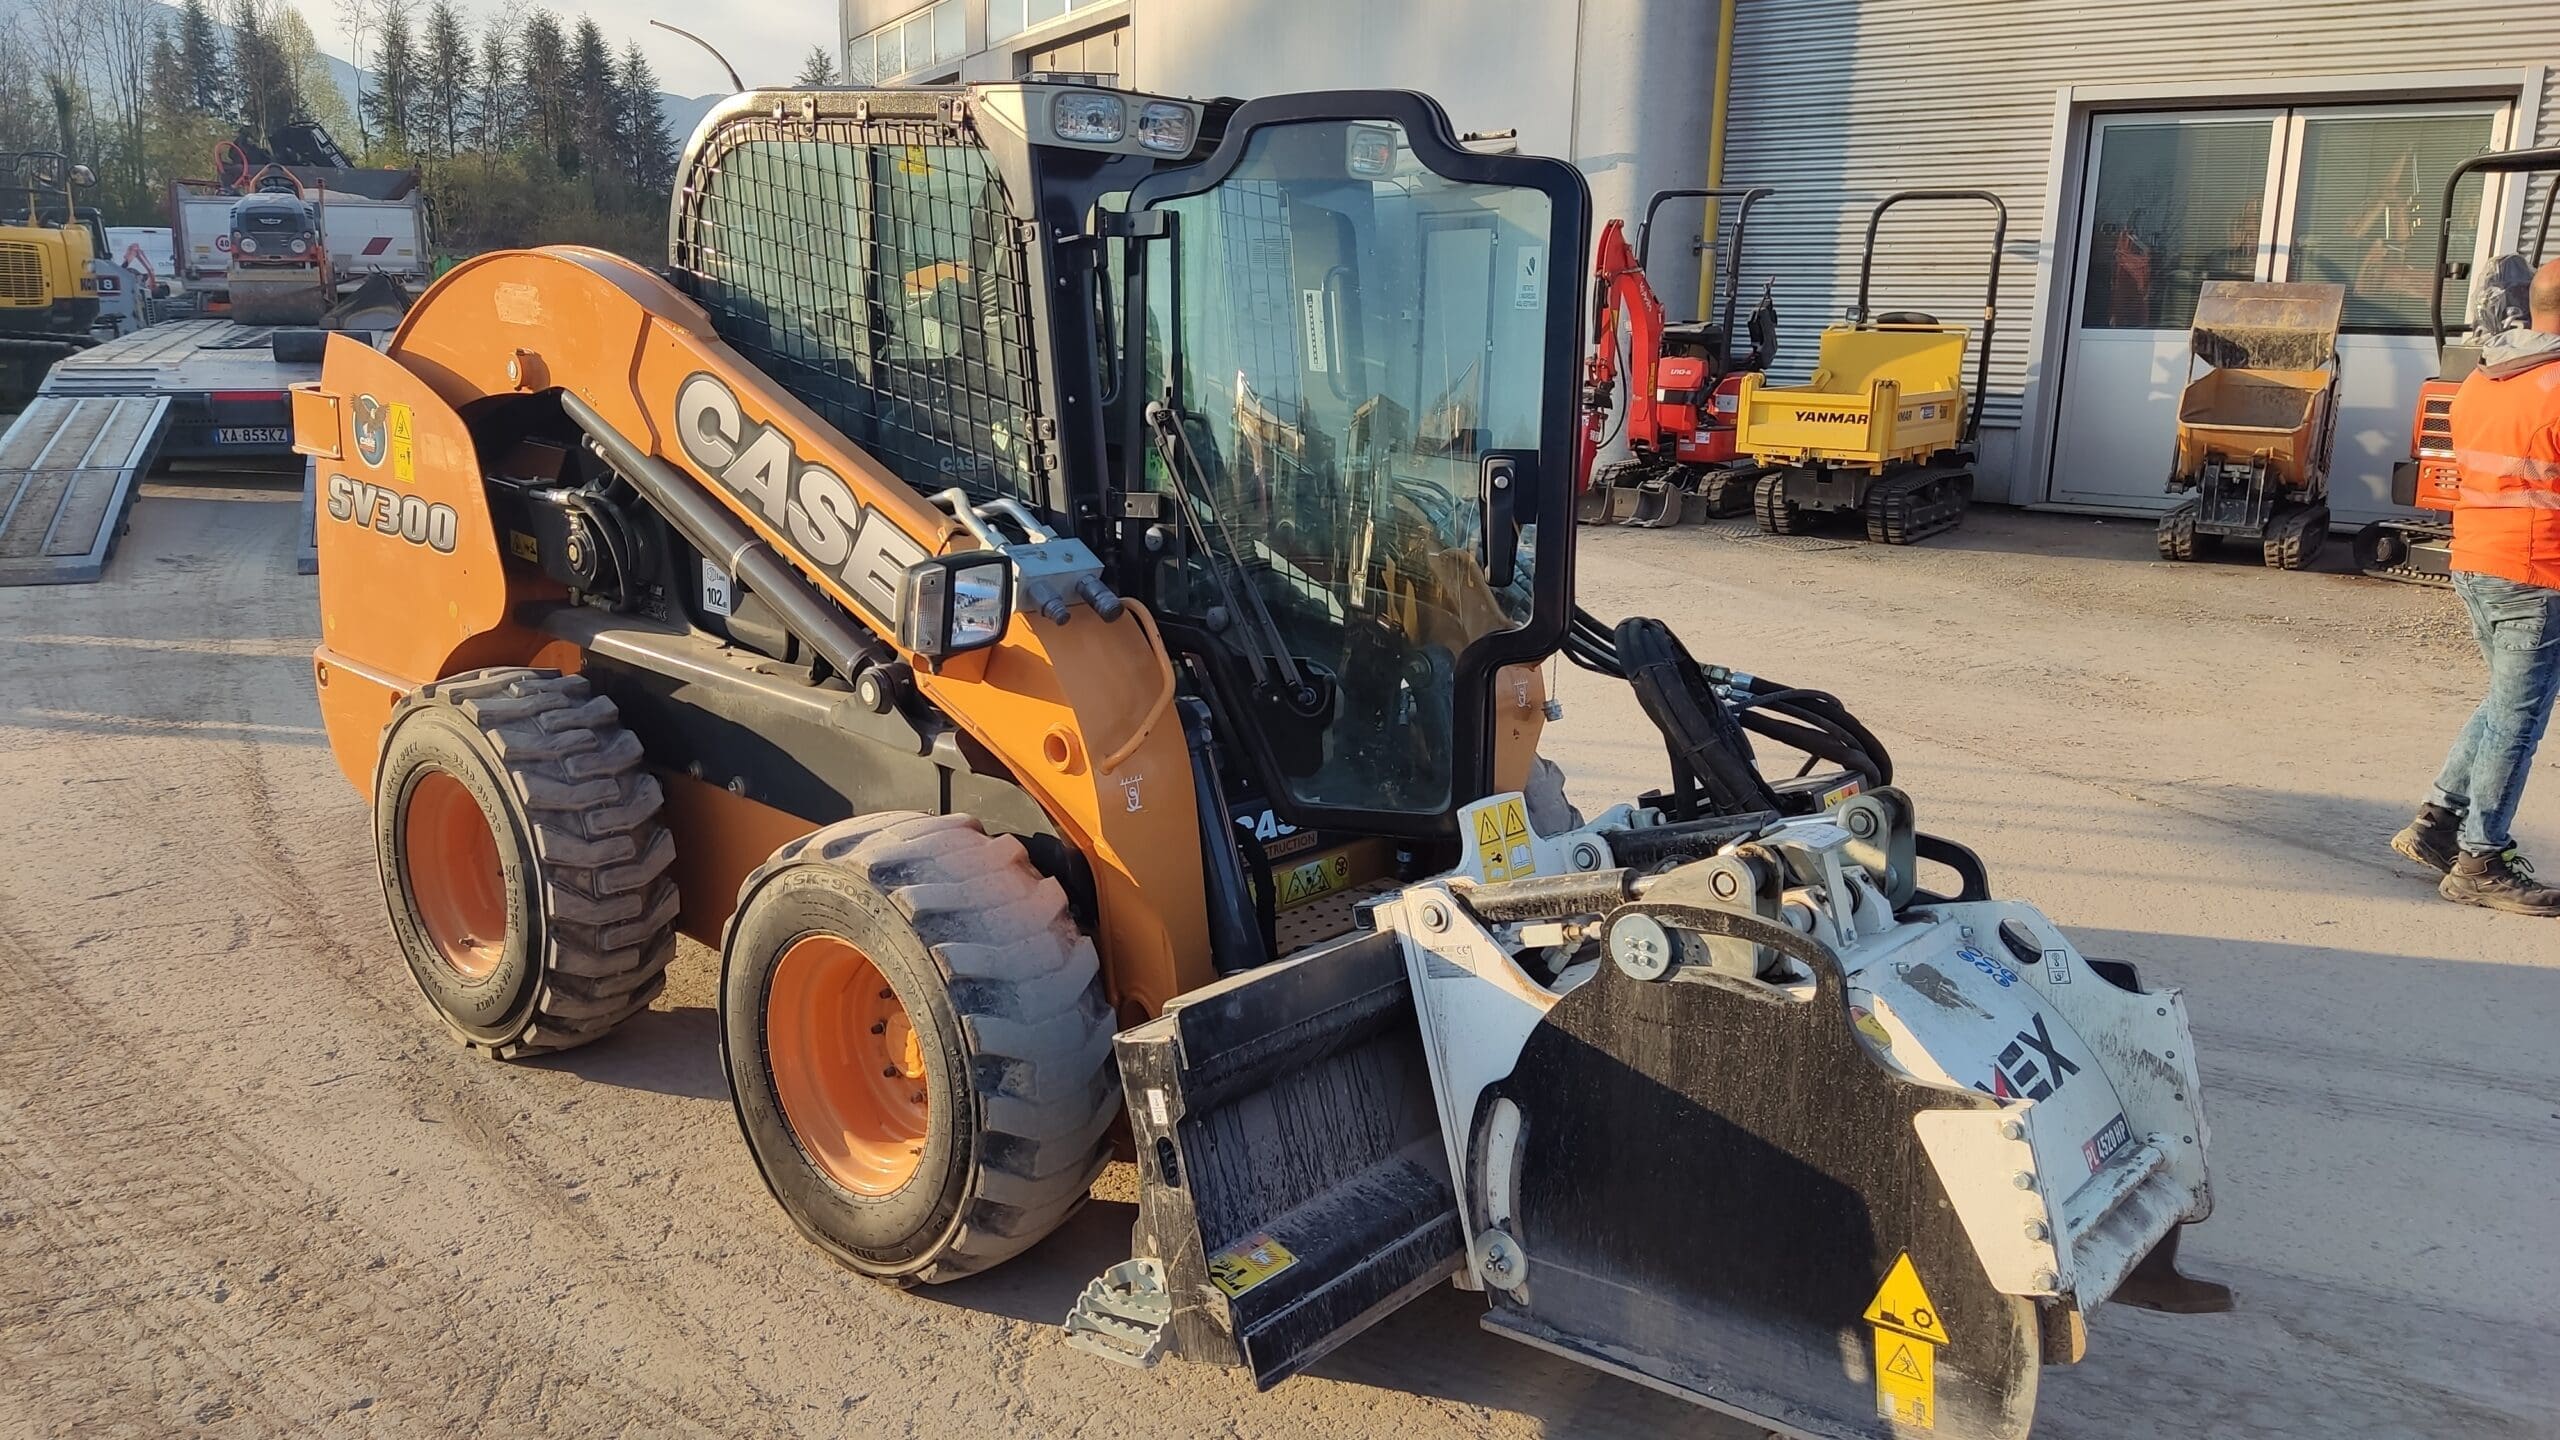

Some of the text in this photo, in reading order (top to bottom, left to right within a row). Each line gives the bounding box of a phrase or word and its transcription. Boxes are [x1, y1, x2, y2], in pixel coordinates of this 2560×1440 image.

[1795, 411, 1868, 425] YANMAR
[221, 429, 287, 442] XA 853KZ
[940, 456, 991, 472] CASE
[678, 376, 925, 622] CASE
[328, 474, 458, 554] SV300
[706, 587, 723, 607] 102
[1265, 833, 1316, 858] TRUCTION
[2084, 1146, 2100, 1170] PL
